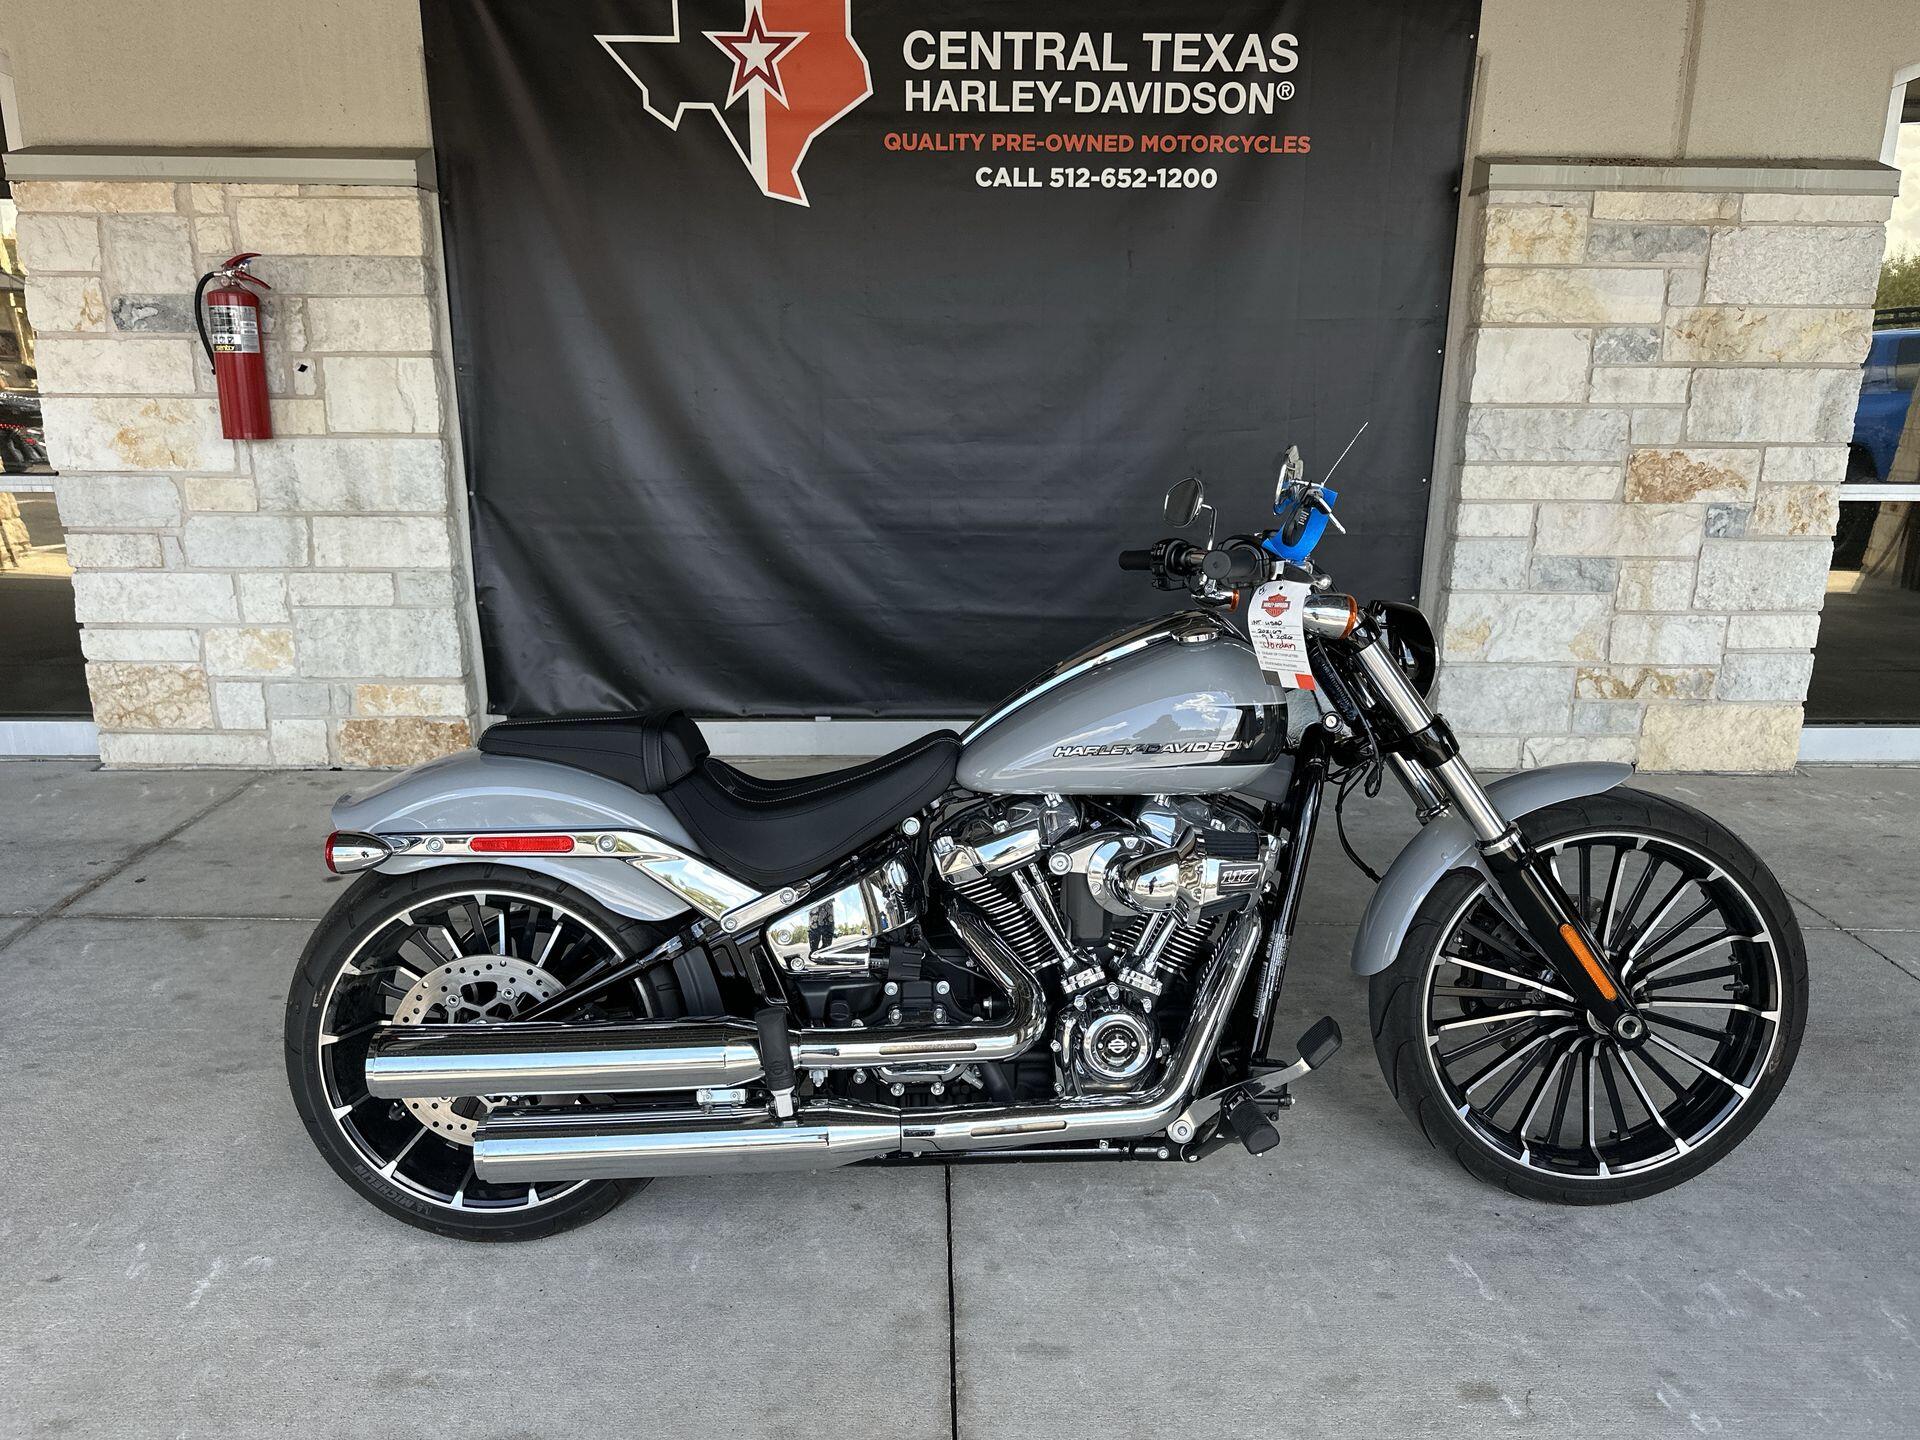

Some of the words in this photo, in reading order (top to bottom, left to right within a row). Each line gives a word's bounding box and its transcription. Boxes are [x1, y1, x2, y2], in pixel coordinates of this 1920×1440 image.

[903, 30, 1127, 71] CENTRAL
[1143, 33, 1298, 73] TEXAS
[884, 133, 985, 151] QUALITY
[993, 134, 1134, 152] PRE-OWNED
[1141, 135, 1310, 153] MOTORCYCLES
[976, 167, 1042, 187] CALL
[1050, 168, 1217, 188] 512-652-1200
[1263, 640, 1296, 651] Jordan
[1053, 739, 1255, 758] HARLEY-DAVIDSON
[1220, 868, 1259, 884] 117
[353, 1163, 415, 1208] MICHELIN
